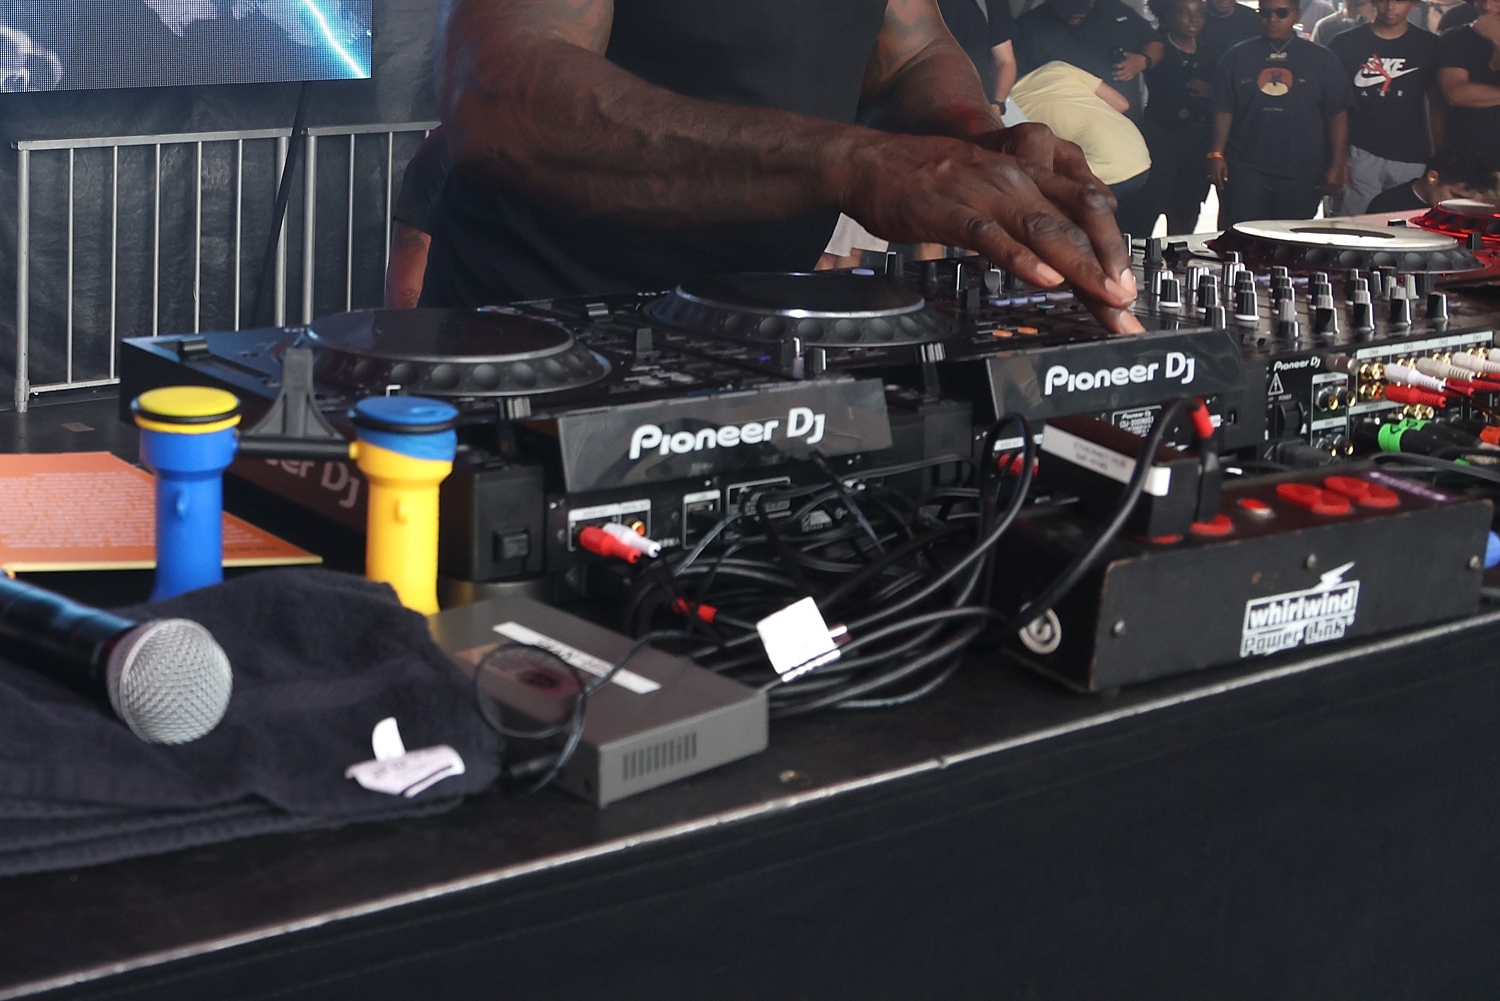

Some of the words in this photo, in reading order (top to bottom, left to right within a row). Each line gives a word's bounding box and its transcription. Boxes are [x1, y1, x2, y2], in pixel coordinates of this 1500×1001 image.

[1044, 362, 1160, 396] Pioneer
[1273, 359, 1309, 372] Pioneer
[628, 419, 779, 460] Pioneer
[1250, 587, 1355, 629] whirlwind
